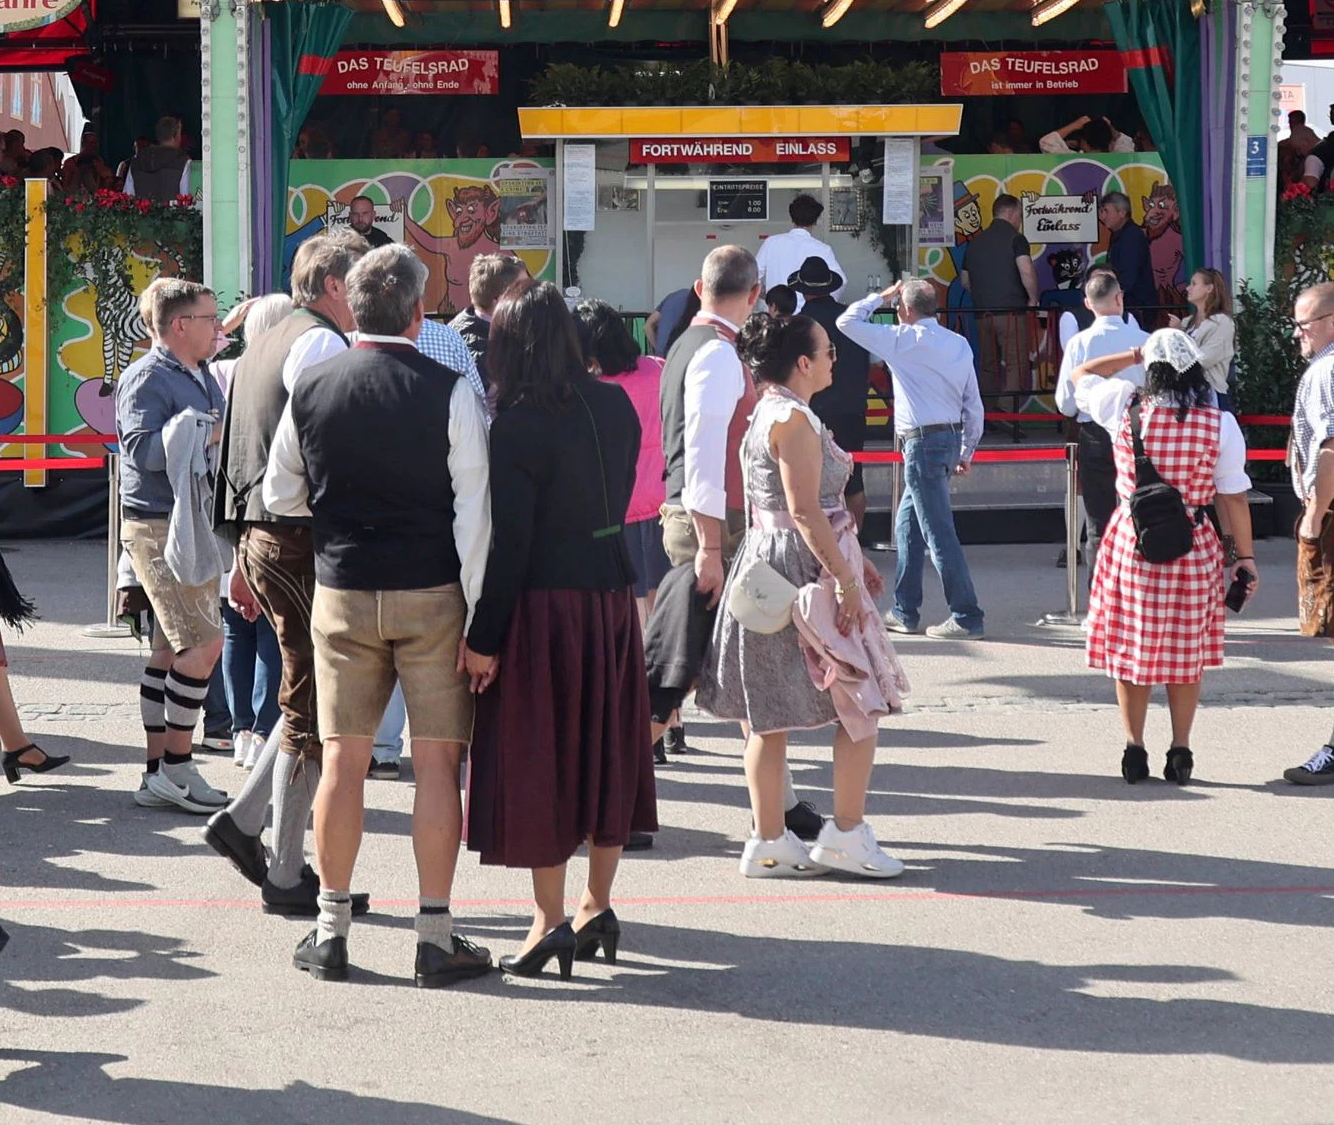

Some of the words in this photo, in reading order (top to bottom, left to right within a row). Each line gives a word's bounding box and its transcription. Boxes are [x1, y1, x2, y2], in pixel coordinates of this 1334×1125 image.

[337, 57, 369, 74] DAS
[373, 57, 470, 75] TEUFELSRAD
[969, 58, 1001, 74] DAS
[1005, 57, 1099, 75] TEUFELSRAD
[346, 81, 369, 90] ohne
[372, 80, 404, 91] Anfang
[412, 81, 434, 90] ohne
[437, 81, 460, 90] Ende
[991, 81, 1003, 90] ist
[1005, 81, 1033, 90] immer
[1035, 81, 1044, 89] in
[1046, 80, 1079, 89] Betrieb
[641, 142, 753, 157] FORTWÄHREND
[775, 141, 837, 156] EINLASS
[1251, 141, 1260, 154] 3
[1025, 203, 1093, 219] Fortwährend
[1036, 217, 1082, 232] Einlass
